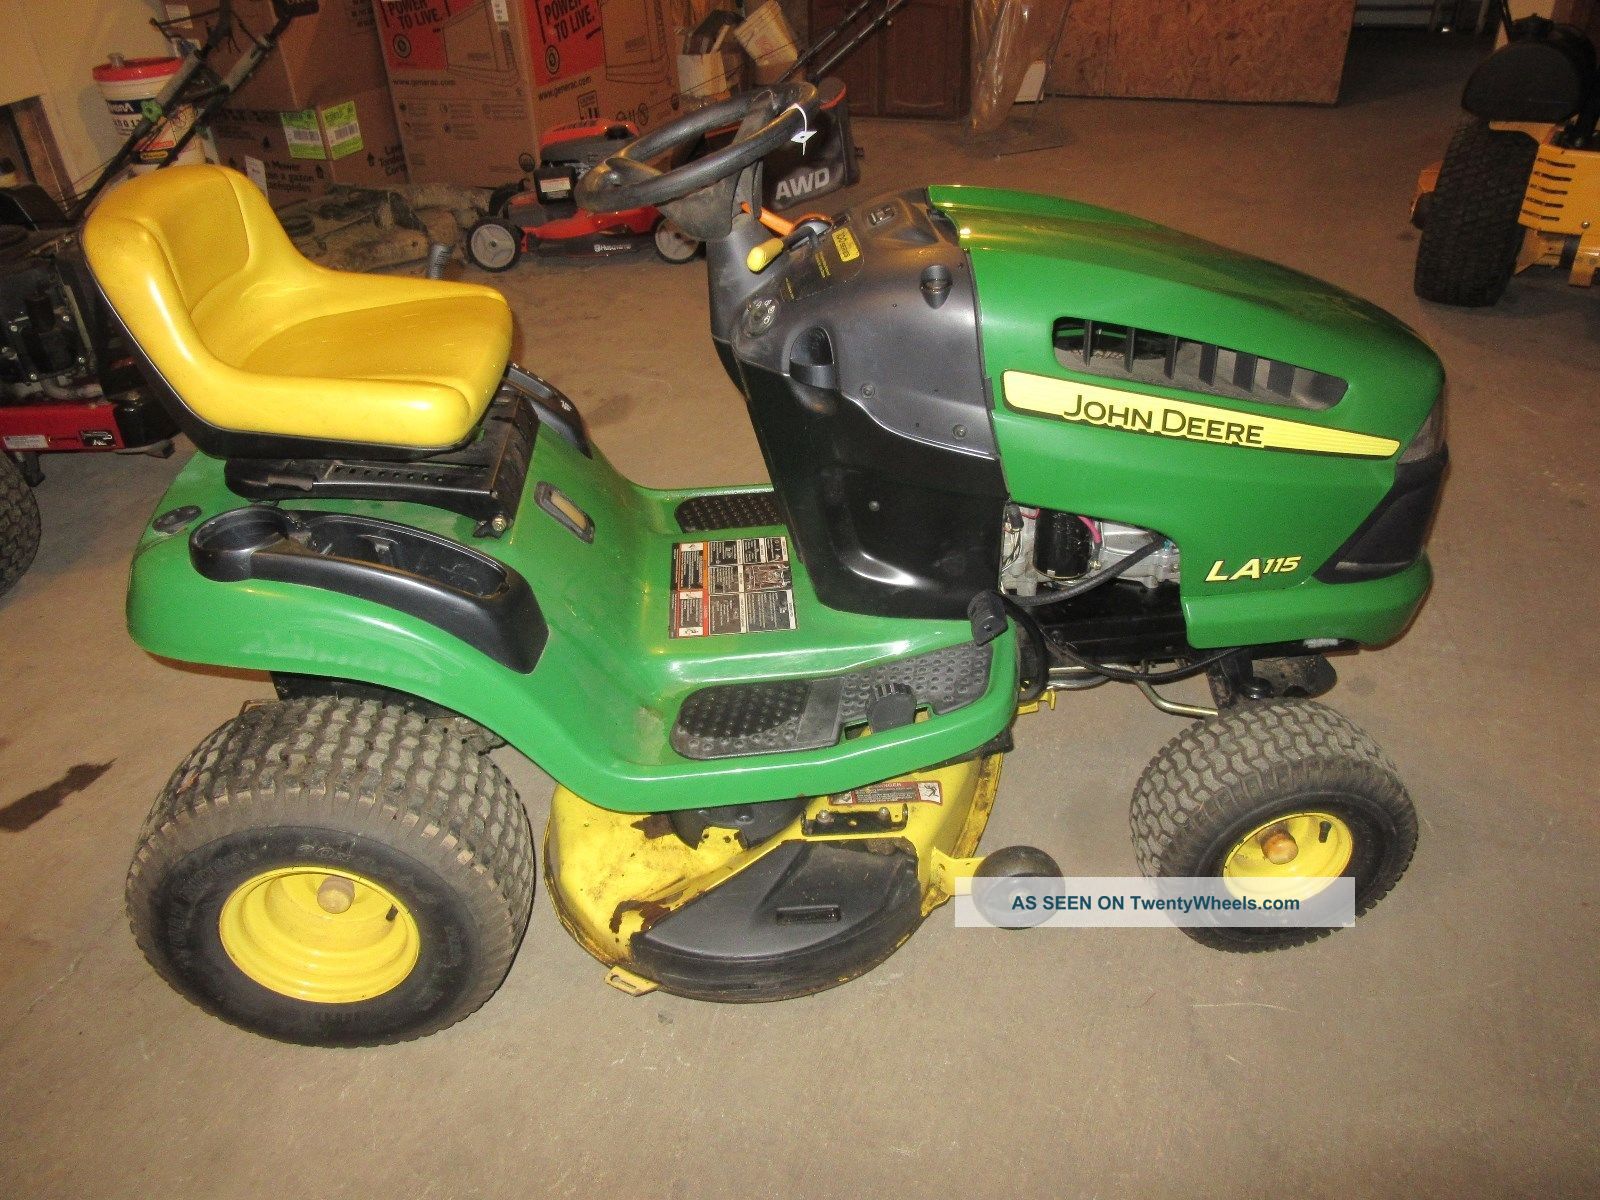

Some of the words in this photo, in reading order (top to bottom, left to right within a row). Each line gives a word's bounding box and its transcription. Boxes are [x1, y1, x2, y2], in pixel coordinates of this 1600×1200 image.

[397, 13, 413, 29] TO
[554, 19, 569, 42] TO
[569, 4, 595, 33] LIVE.
[775, 167, 830, 200] AWD
[1063, 394, 1153, 430] JOHN
[1161, 408, 1265, 445] DEERE
[1205, 556, 1302, 582] LA115
